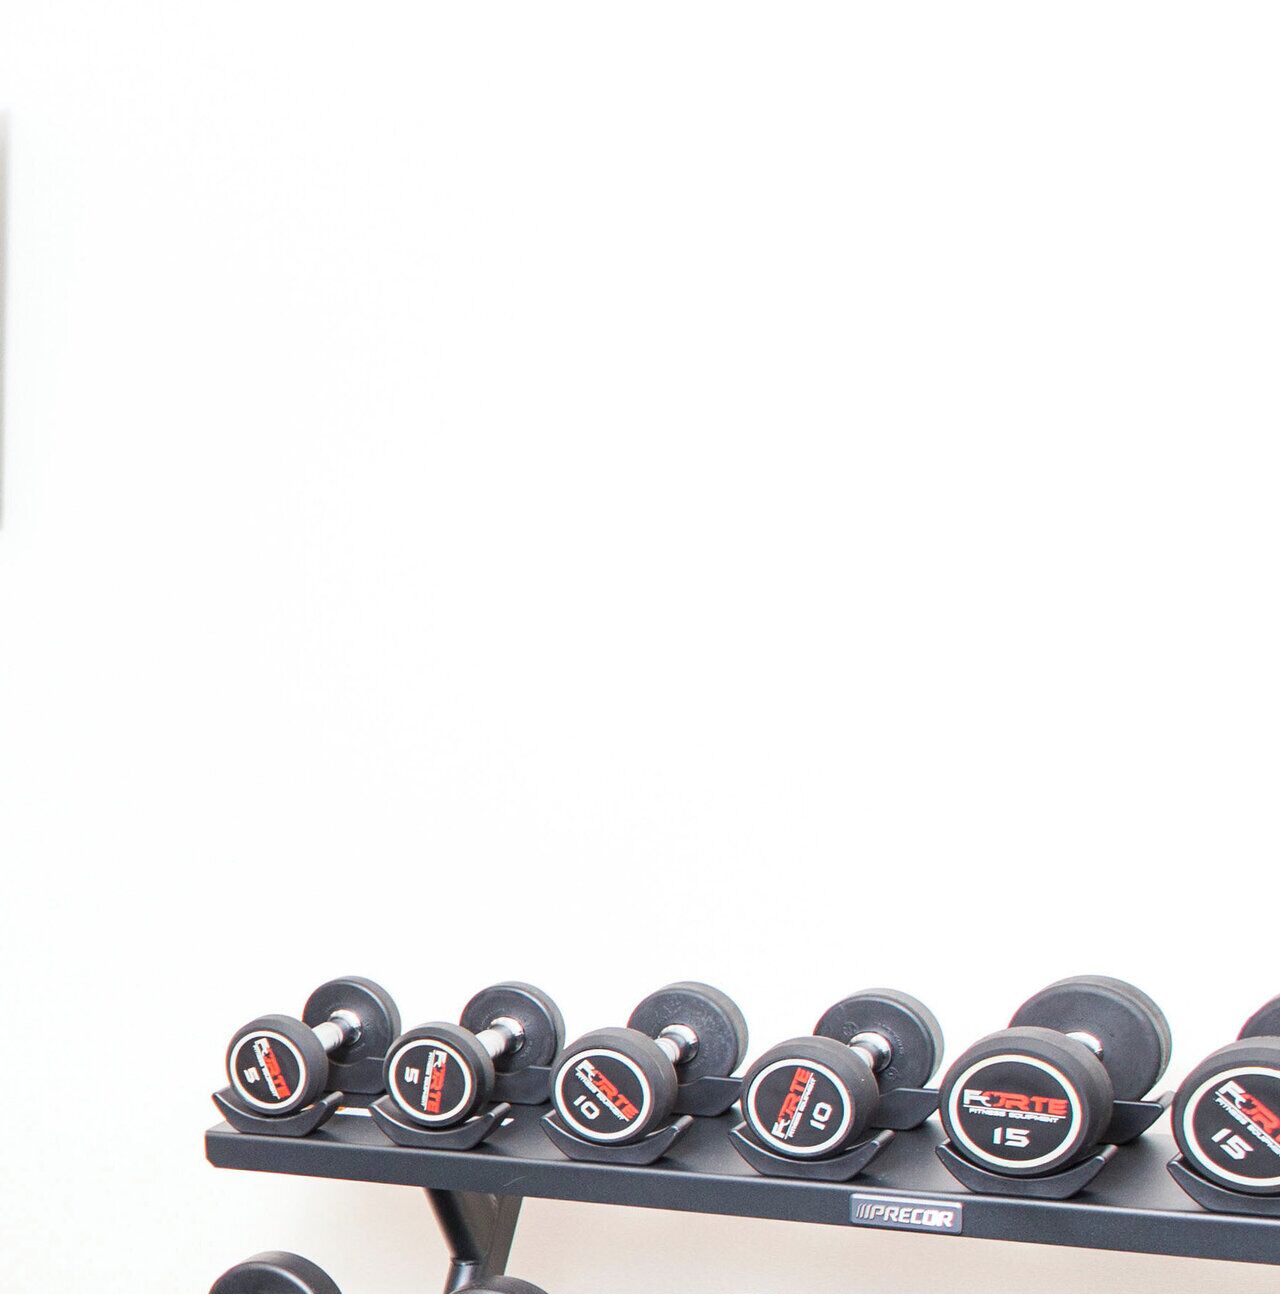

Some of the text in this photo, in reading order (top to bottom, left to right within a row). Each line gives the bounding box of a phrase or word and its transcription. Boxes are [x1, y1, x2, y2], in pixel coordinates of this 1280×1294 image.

[243, 1067, 260, 1083] 5
[404, 1066, 420, 1084] 5
[573, 1095, 600, 1120] 10
[963, 1089, 1069, 1116] FORTE
[1218, 1080, 1280, 1144] FOR
[809, 1101, 833, 1131] 10
[993, 1126, 1030, 1148] 15
[1211, 1128, 1254, 1160] 15
[869, 1204, 954, 1228] PRECOR
